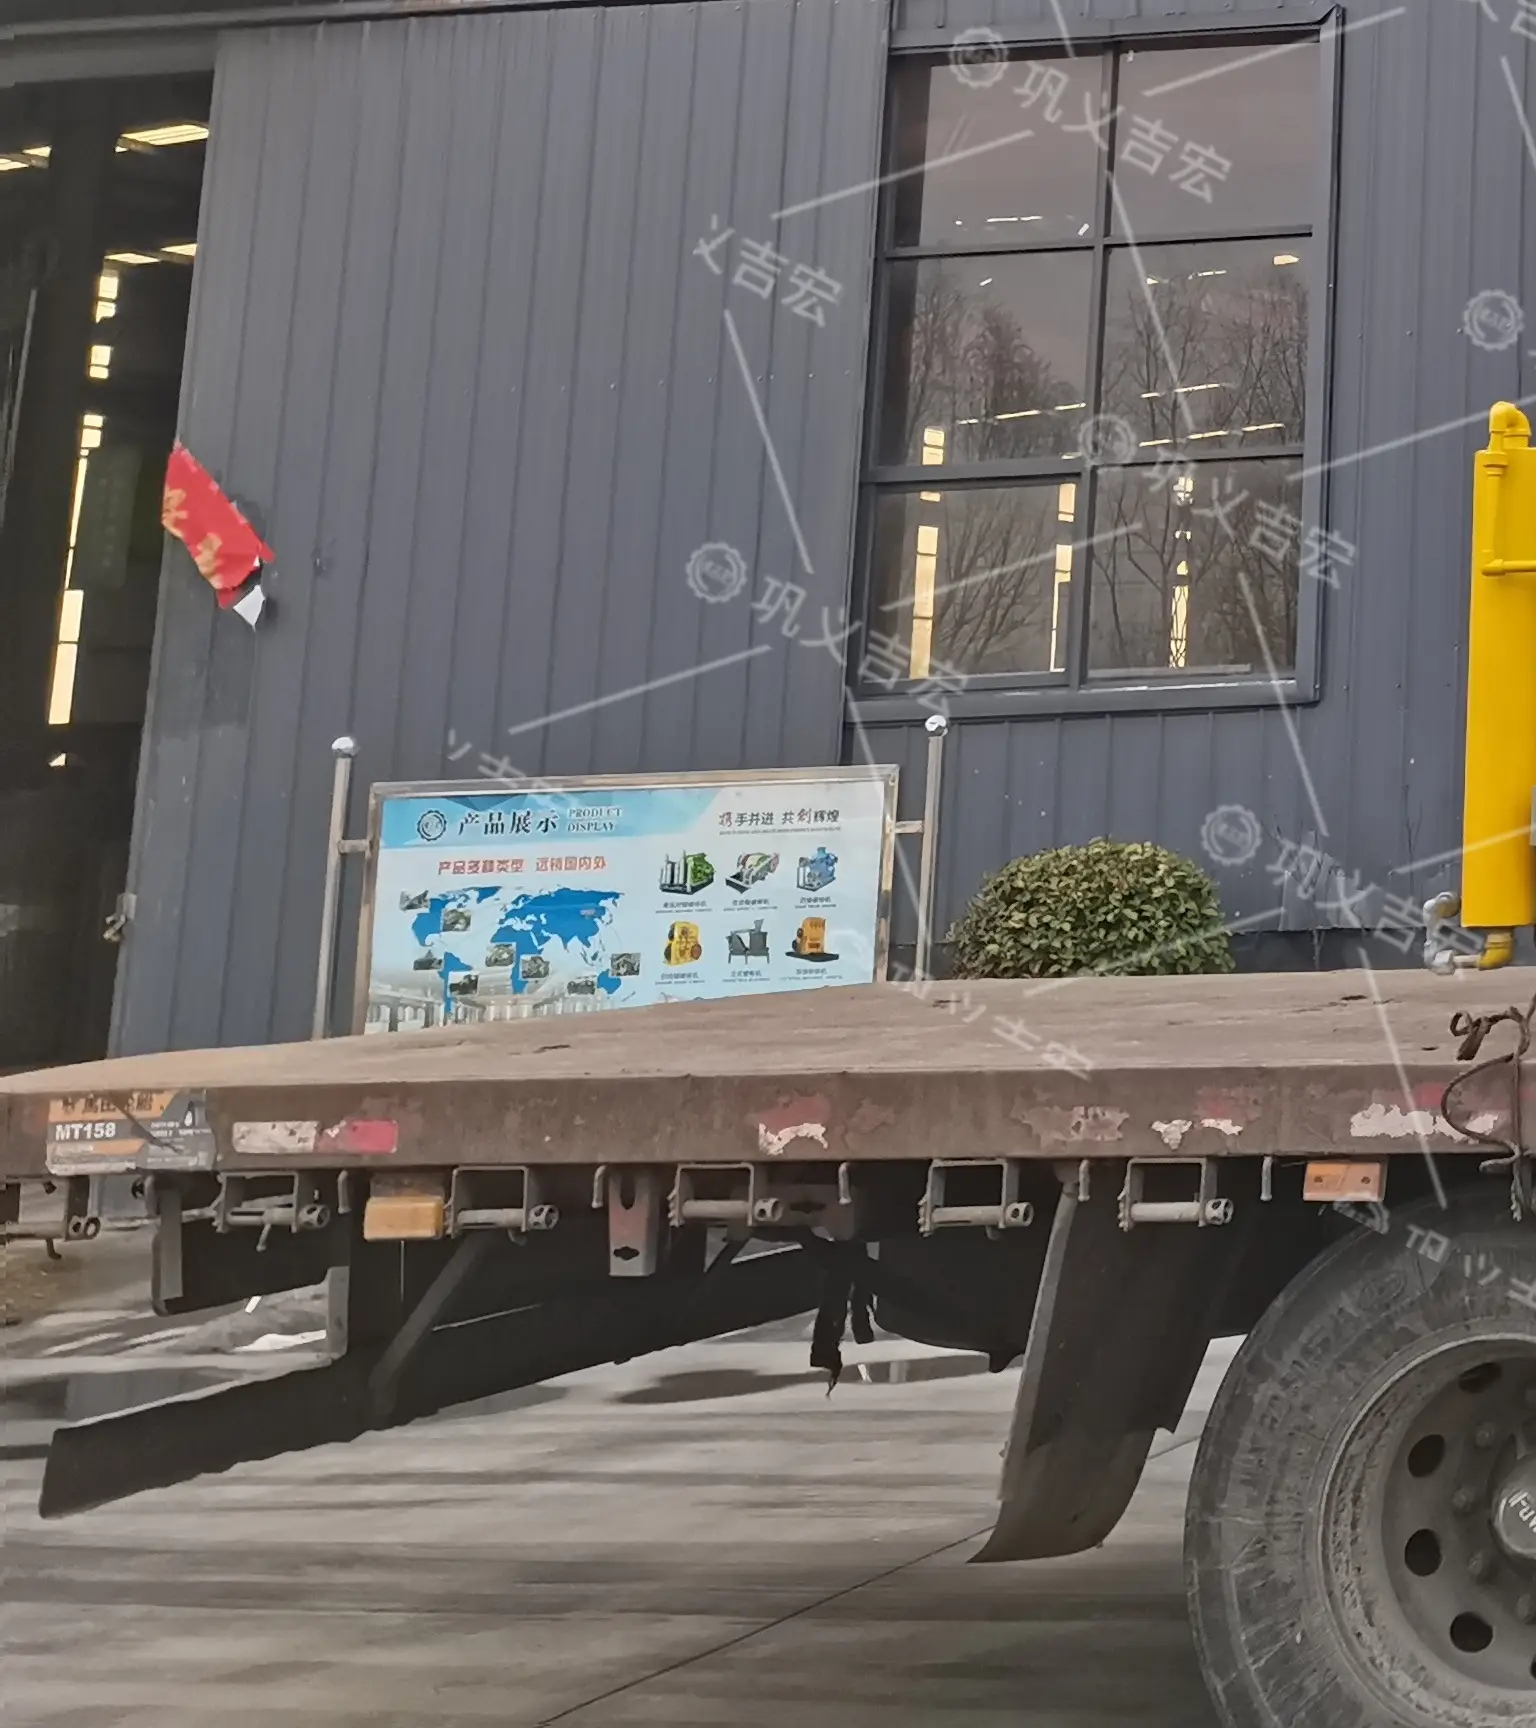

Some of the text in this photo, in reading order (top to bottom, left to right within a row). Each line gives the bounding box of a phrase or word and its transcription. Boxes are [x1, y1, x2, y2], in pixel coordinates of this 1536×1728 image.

[459, 809, 558, 835] 产品展示
[55, 1122, 117, 1141] MT158
